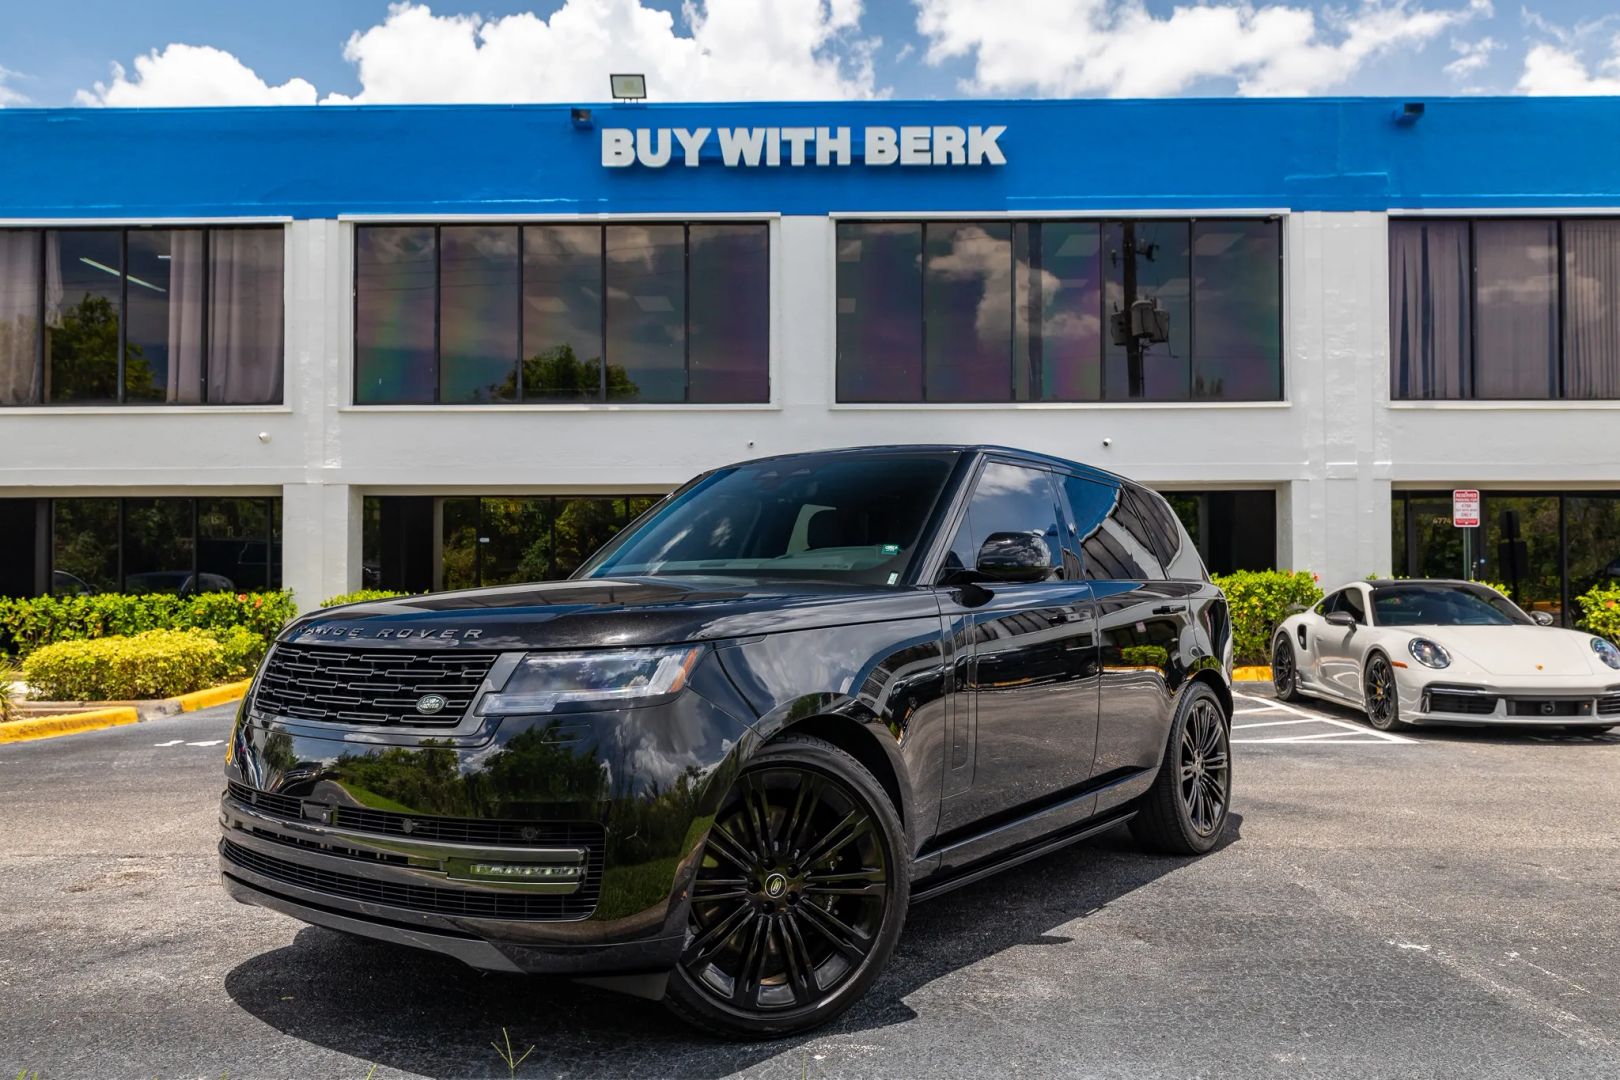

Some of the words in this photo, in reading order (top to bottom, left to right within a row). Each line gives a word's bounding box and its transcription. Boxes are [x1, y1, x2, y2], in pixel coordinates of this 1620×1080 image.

[601, 128, 712, 167] BUY
[717, 127, 851, 167] WITH
[864, 126, 1007, 166] BERK
[376, 628, 483, 639] ROVER
